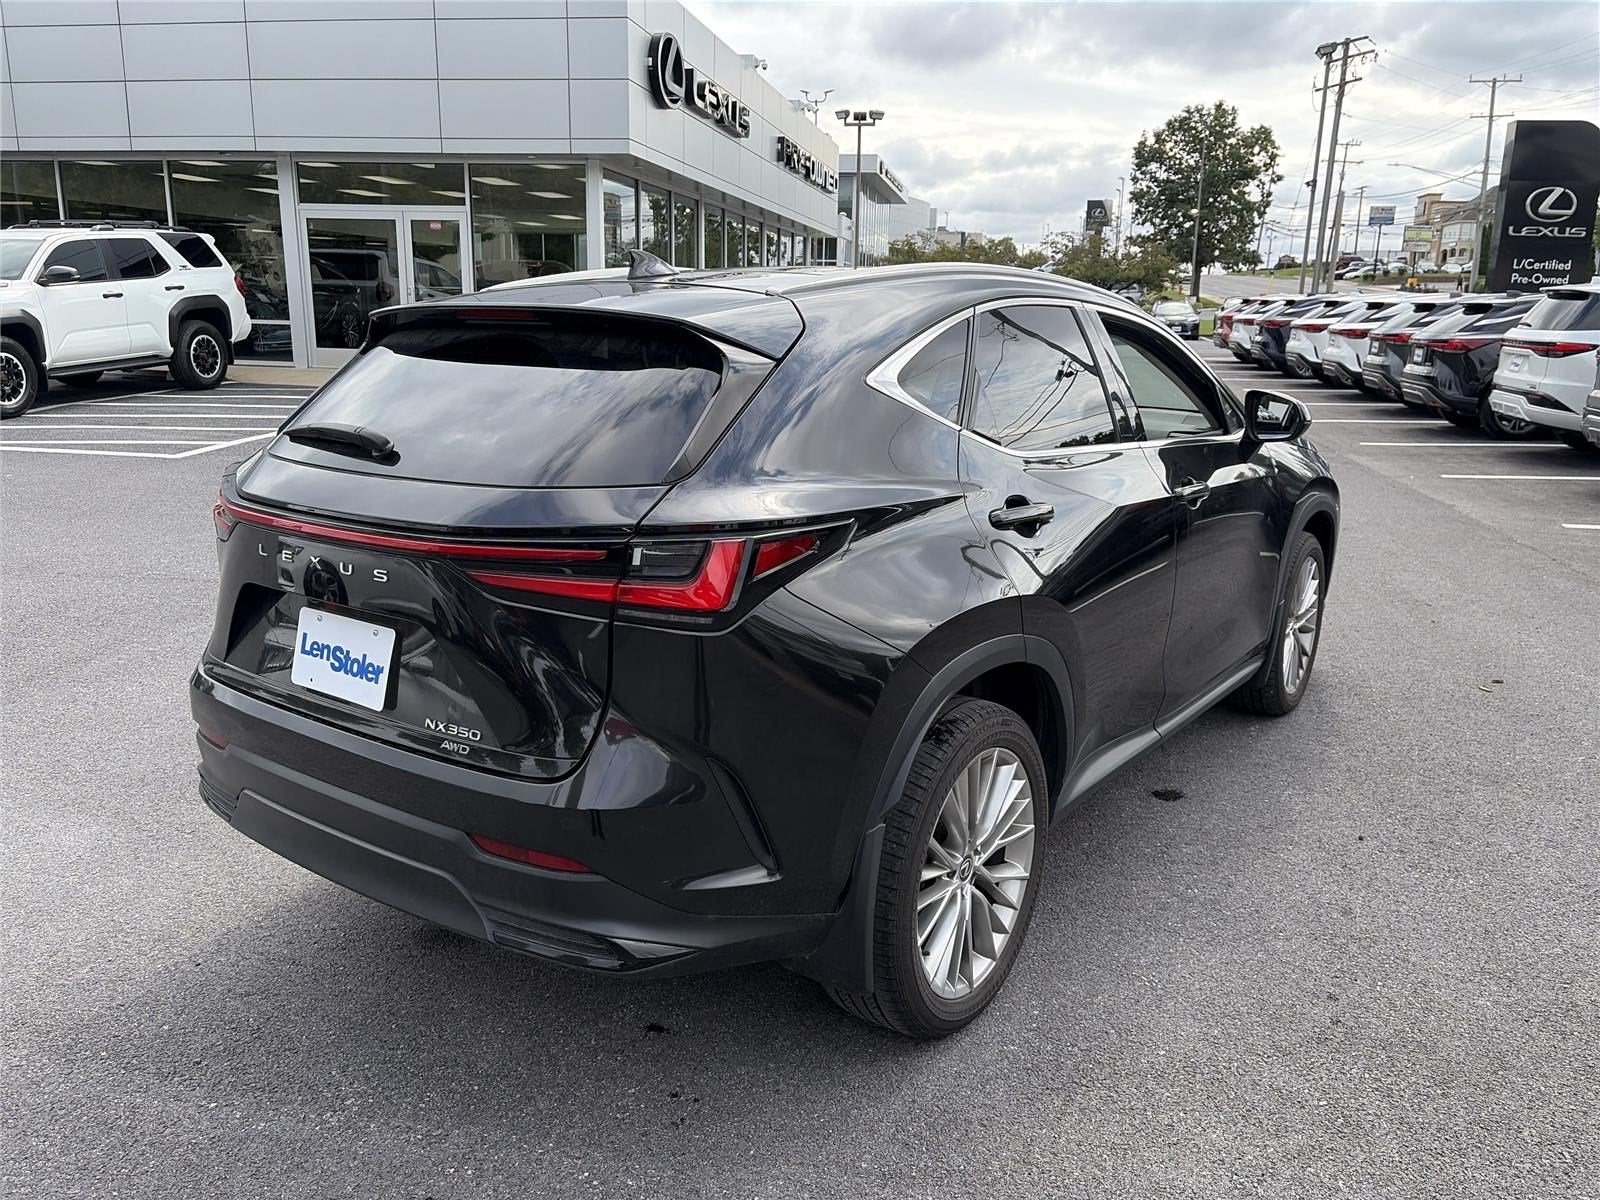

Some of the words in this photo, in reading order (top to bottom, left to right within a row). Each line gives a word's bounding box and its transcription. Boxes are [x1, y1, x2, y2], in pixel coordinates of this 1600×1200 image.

[684, 68, 751, 138] LEXUS
[1508, 226, 1587, 238] LEXUS
[1512, 258, 1572, 271] L/Certified
[1511, 273, 1570, 285] Pre-Owned
[258, 543, 389, 584] LEXUS
[424, 717, 481, 741] NX350
[440, 740, 470, 755] AWD
